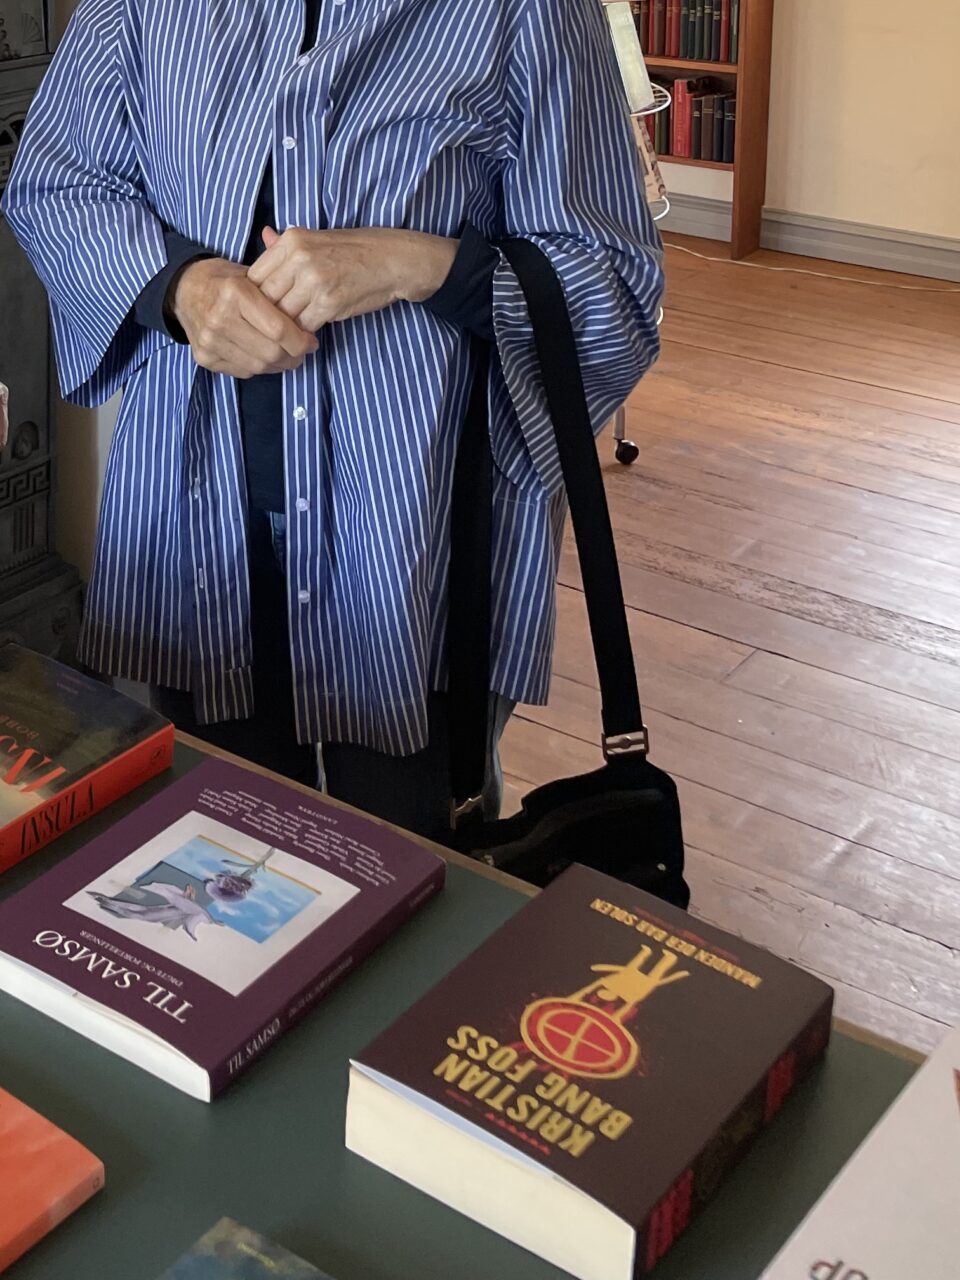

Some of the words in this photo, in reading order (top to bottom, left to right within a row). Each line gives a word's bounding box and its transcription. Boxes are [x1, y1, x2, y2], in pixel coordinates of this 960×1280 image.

[32, 928, 141, 989] SAMSØ
[141, 980, 194, 1025] TIL
[446, 1024, 538, 1084] FOSS
[432, 1052, 595, 1159] KRISTIAN
[535, 1071, 633, 1142] BANG
